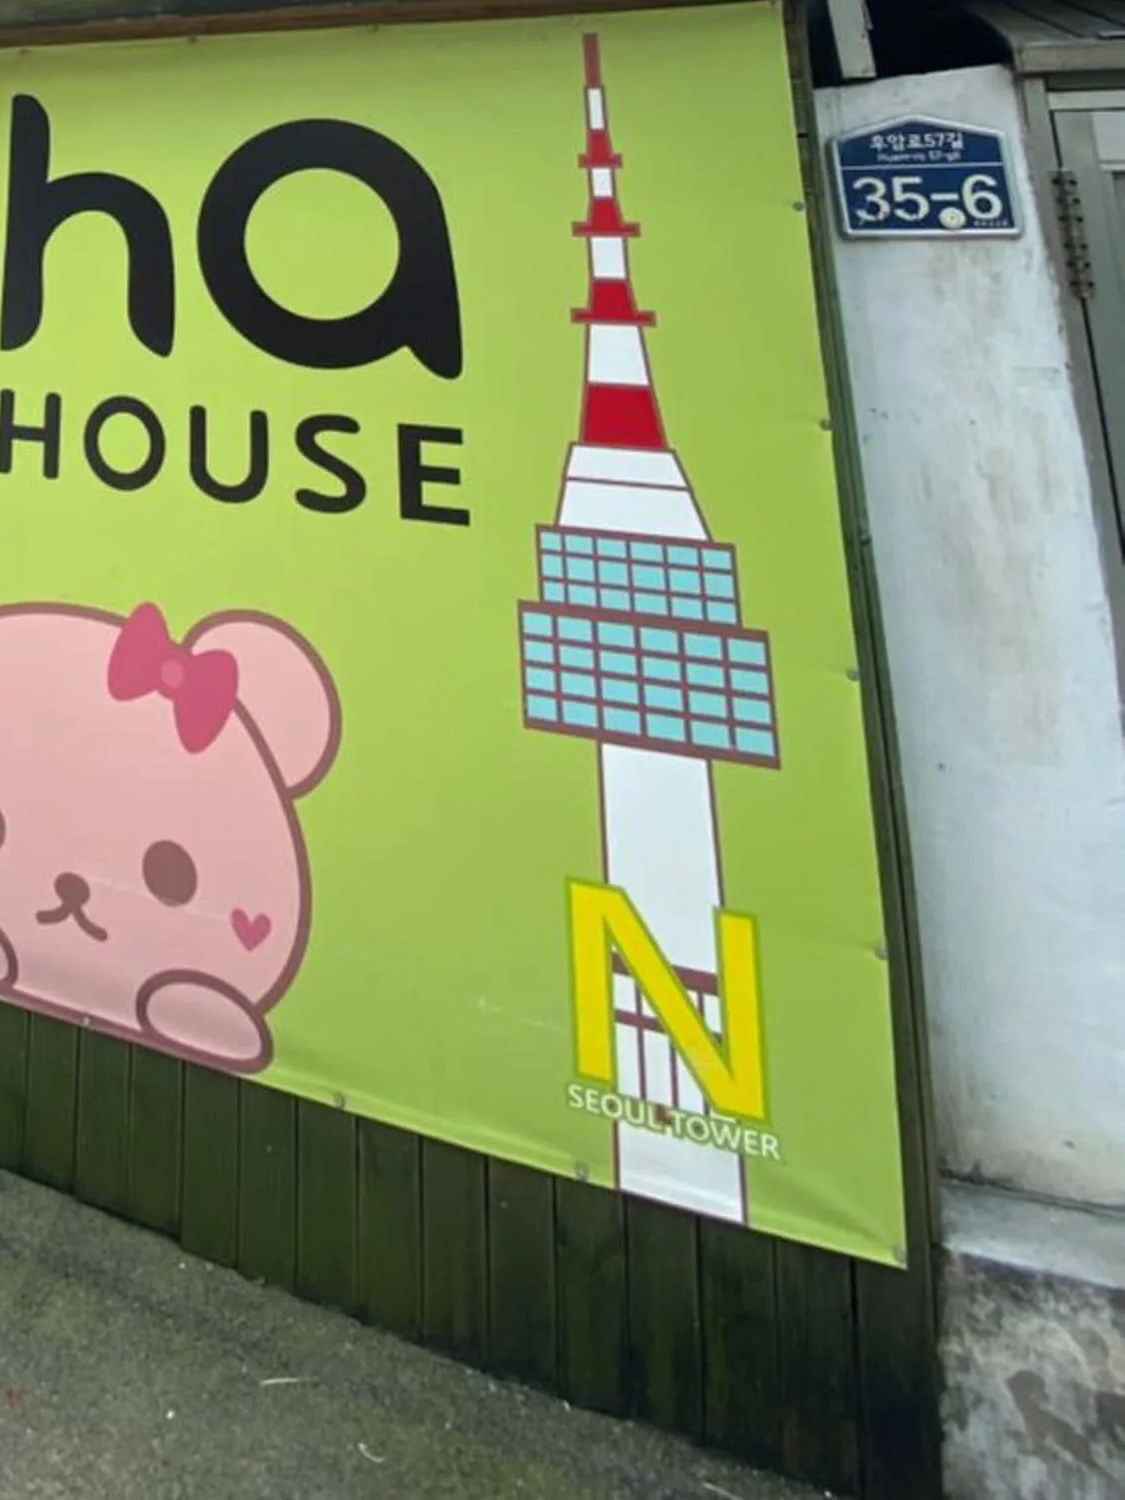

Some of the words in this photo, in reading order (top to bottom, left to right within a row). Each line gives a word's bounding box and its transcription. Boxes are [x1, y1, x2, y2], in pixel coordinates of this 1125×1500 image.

[851, 174, 1003, 222] 35-6
[568, 880, 768, 1122] N
[567, 1084, 664, 1130] SEOUL
[666, 1112, 781, 1161] TOWER
